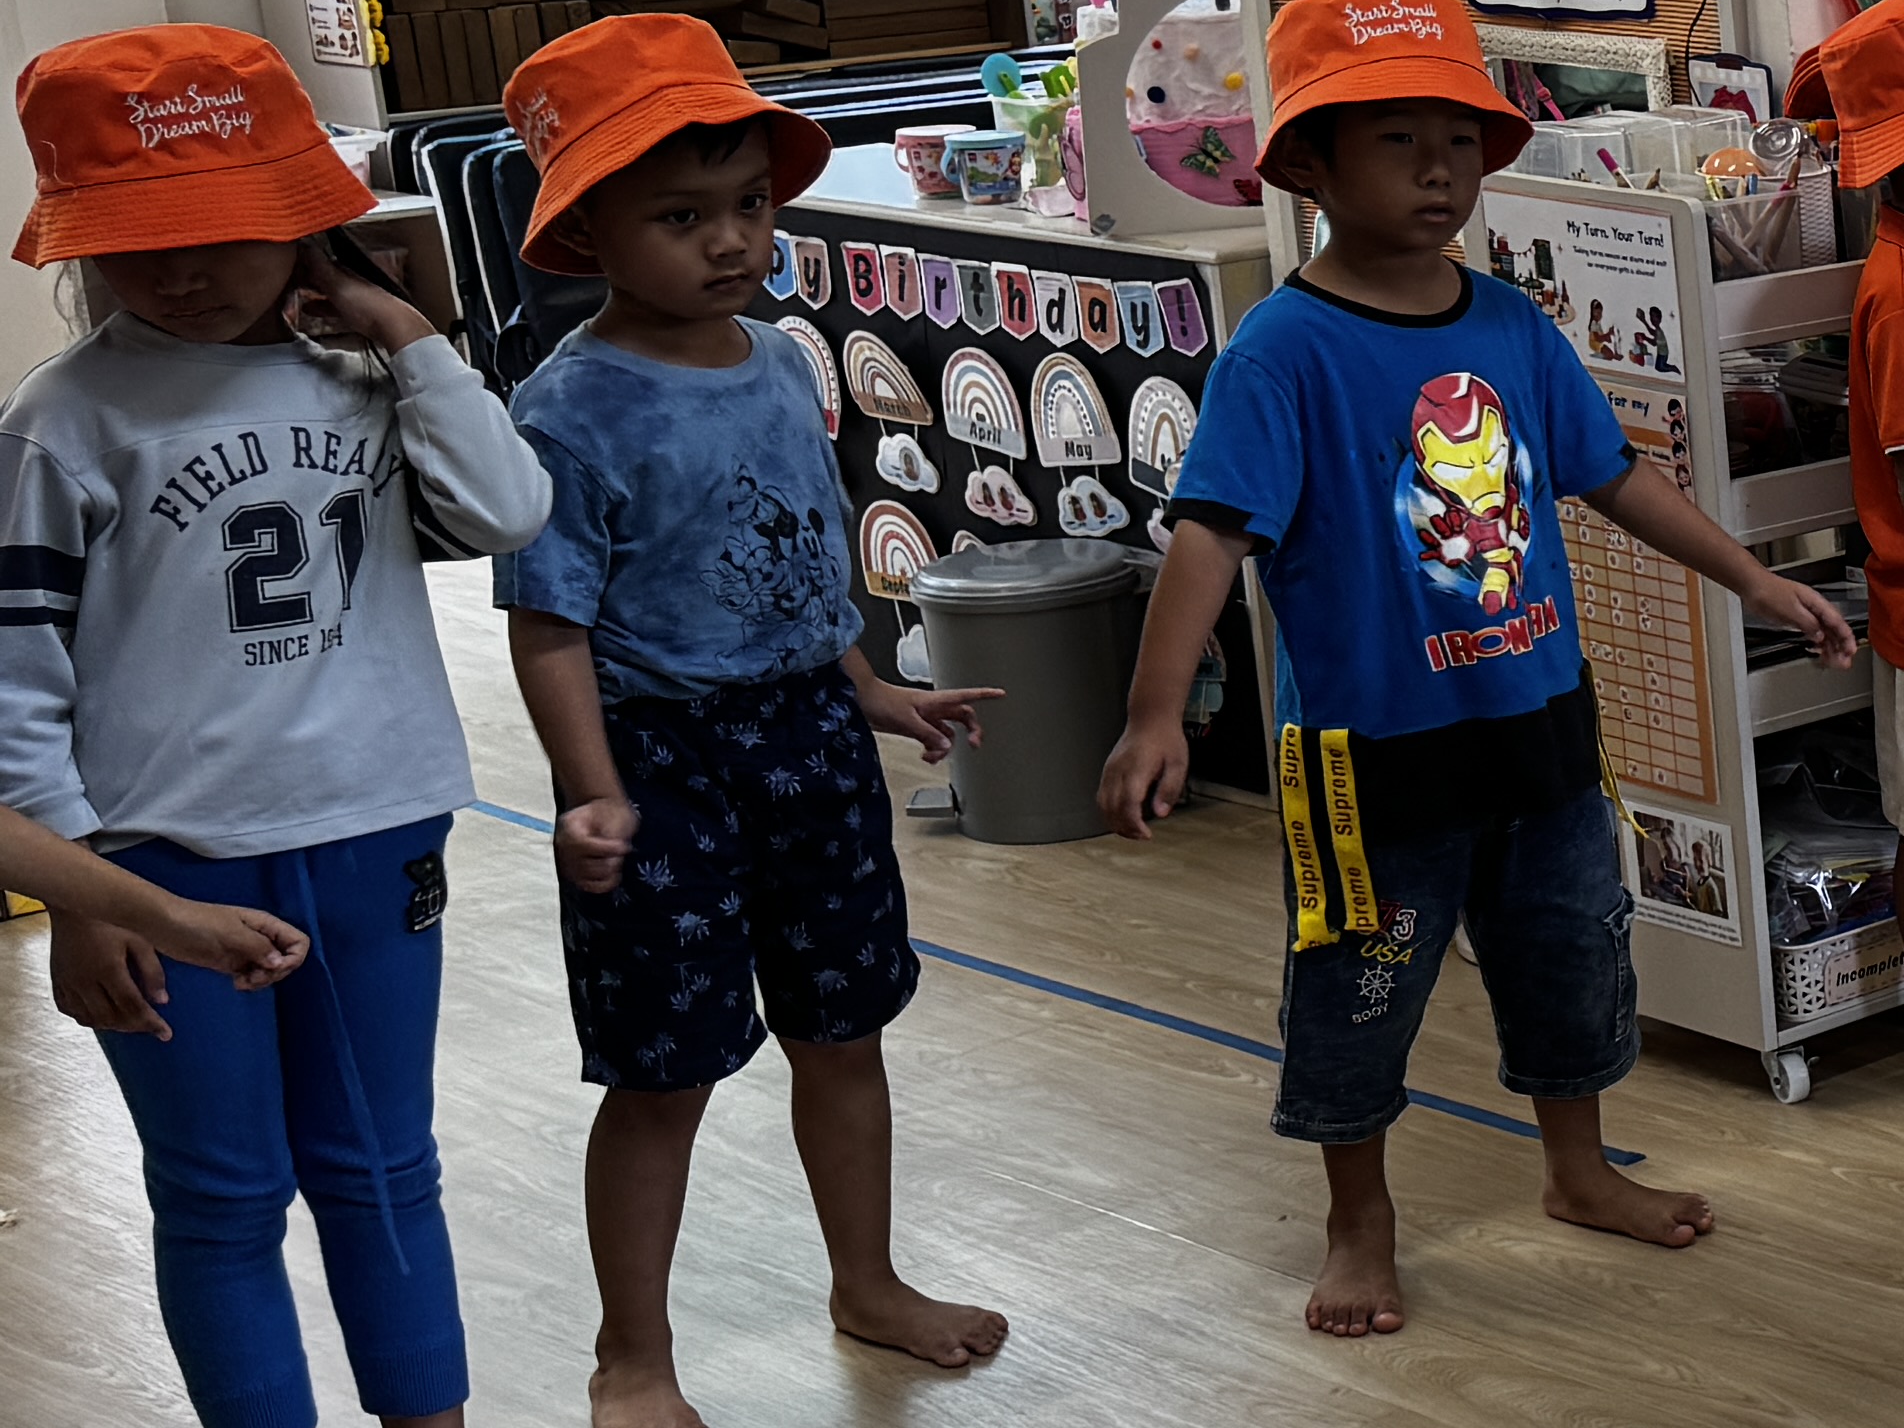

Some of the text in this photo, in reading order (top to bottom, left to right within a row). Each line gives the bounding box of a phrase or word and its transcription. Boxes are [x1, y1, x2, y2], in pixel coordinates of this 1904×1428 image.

[1345, 2, 1392, 28] Start
[1351, 22, 1410, 46] Dream
[125, 83, 245, 124] Start Small
[138, 110, 253, 148] Dream Big
[1566, 219, 1581, 238] My
[1610, 227, 1635, 243] Your
[850, 252, 1189, 349] Birthday!
[969, 422, 1001, 445] April
[1064, 439, 1094, 461] May
[149, 430, 269, 533] FIELD
[221, 488, 368, 634] 21
[243, 634, 310, 667] SINCE
